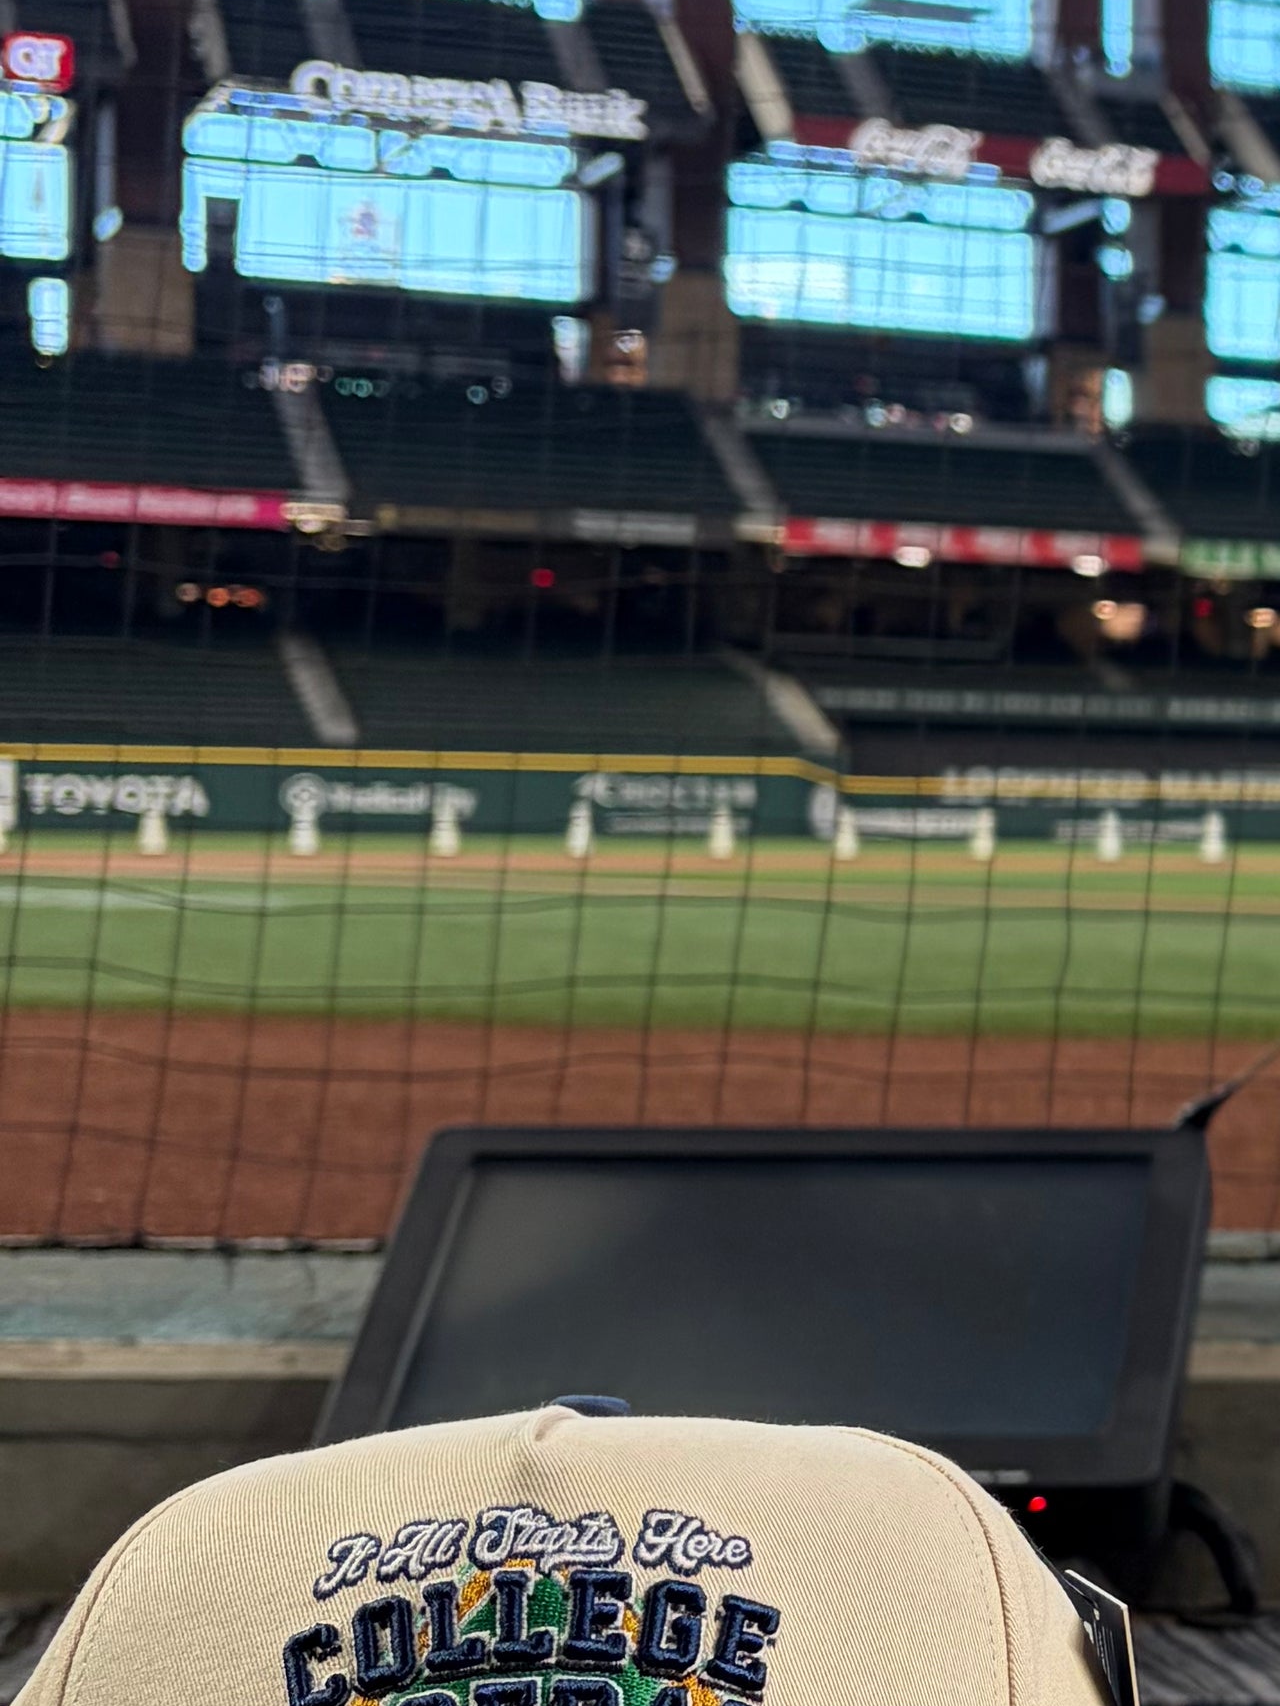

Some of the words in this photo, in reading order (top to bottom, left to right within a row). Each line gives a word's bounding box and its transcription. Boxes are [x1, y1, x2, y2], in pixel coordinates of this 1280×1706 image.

[25, 773, 210, 817] TOYOTA
[377, 1518, 469, 1582] All
[470, 1503, 625, 1574] Starts
[633, 1508, 752, 1576] Here
